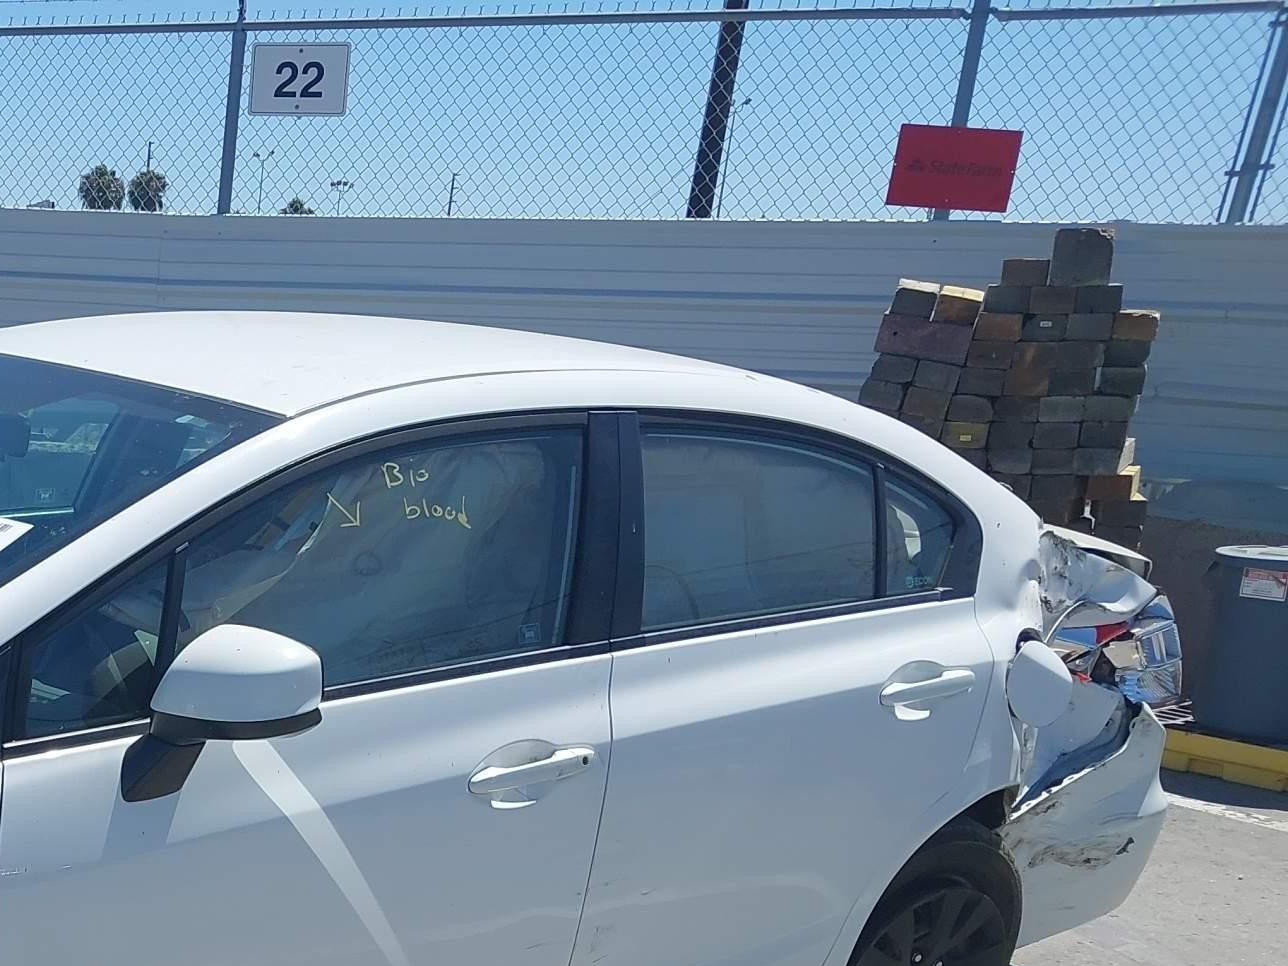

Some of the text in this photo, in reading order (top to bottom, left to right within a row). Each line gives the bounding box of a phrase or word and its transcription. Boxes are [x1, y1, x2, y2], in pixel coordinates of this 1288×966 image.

[272, 60, 325, 99] 22
[380, 458, 430, 488] Bio
[403, 495, 472, 529] blood
